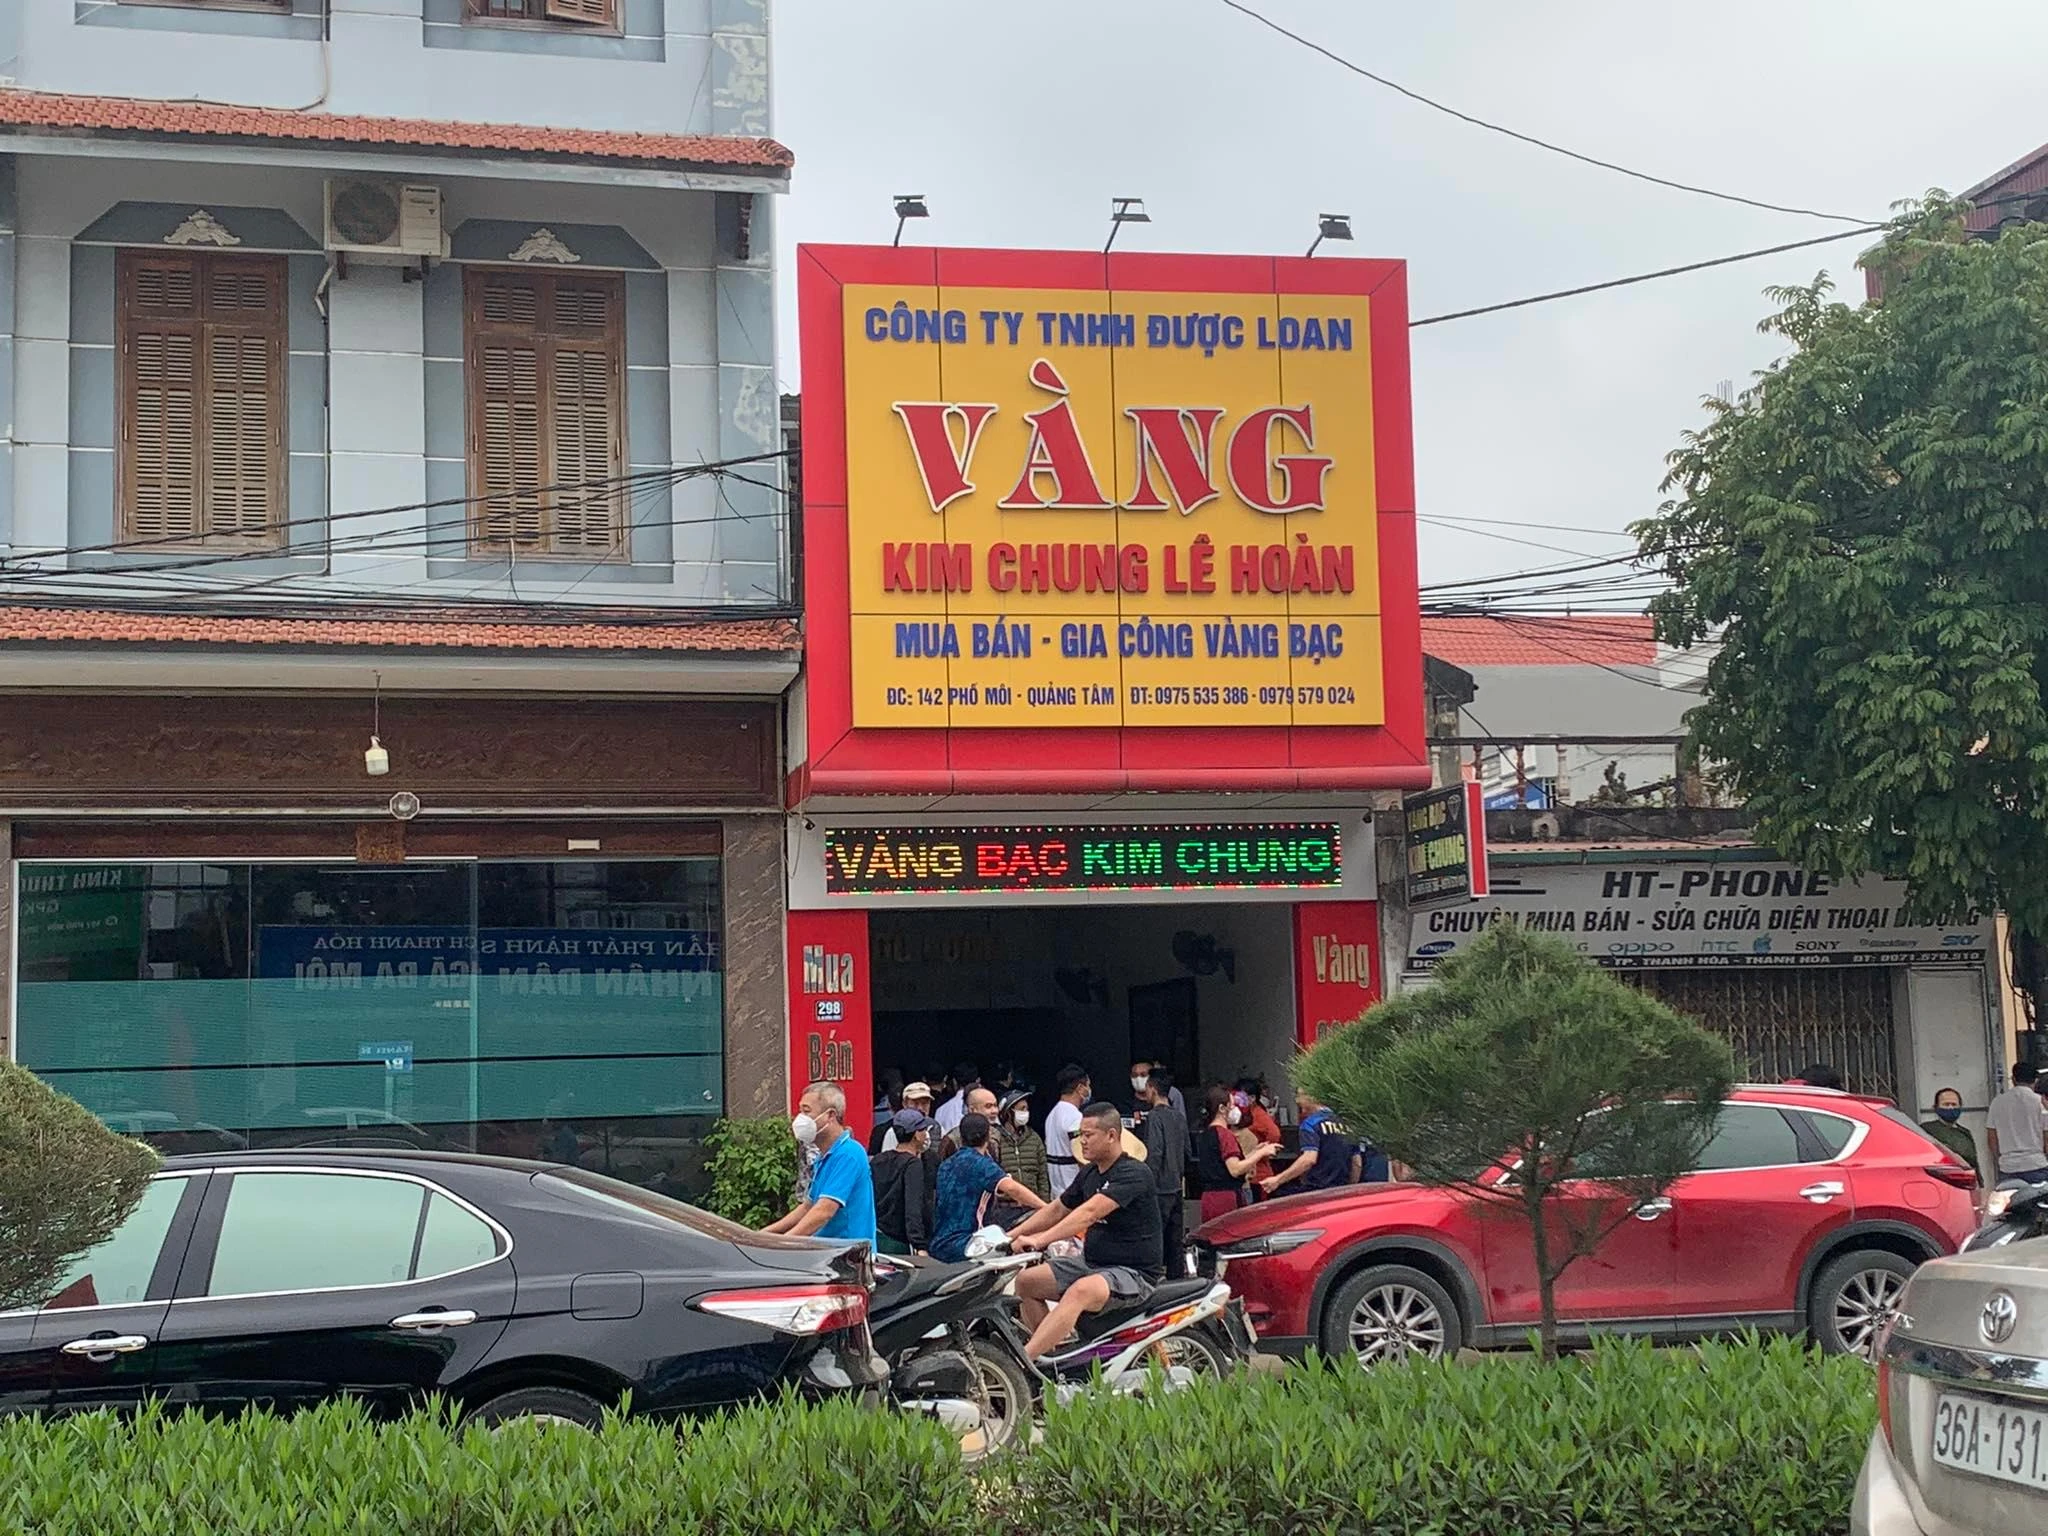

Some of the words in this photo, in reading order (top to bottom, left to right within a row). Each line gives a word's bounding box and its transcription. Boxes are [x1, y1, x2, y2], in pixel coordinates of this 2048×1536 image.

[865, 300, 966, 343] CÔNG
[980, 312, 1022, 344] TY
[1037, 313, 1135, 347] TNHH
[1147, 313, 1243, 357] ĐƯỢC
[1258, 317, 1352, 351] LOAN
[892, 358, 1336, 515] VÀNG
[883, 542, 972, 594] KIM
[988, 543, 1149, 594] CHUNG
[1164, 534, 1216, 594] LÊ
[1231, 533, 1354, 594] HOÀN
[895, 623, 960, 658] MUA
[972, 616, 1031, 658] BÁN
[1061, 623, 1108, 658] GIA
[1119, 616, 1193, 658] CÔNG
[1207, 616, 1278, 658] VÀNG
[1289, 623, 1343, 666] BẠC
[887, 687, 912, 705] ĐC:
[917, 687, 943, 705] 142
[948, 682, 978, 705] PHỐ
[985, 683, 1012, 705] MÔI
[1027, 682, 1076, 707] QUẢNG
[1082, 683, 1114, 705] TÂM
[1155, 687, 1190, 704] 0975
[1193, 687, 1219, 704] 535
[1223, 687, 1248, 704] 386
[1259, 687, 1294, 704] 0979
[1298, 687, 1324, 704] 579
[1328, 687, 1355, 704] 024
[834, 834, 962, 878] VÀNG
[976, 840, 1069, 882] BẠC
[1082, 839, 1163, 876] KIM
[1175, 838, 1333, 875] CHUNG
[1601, 870, 1830, 898] HT-PHONE
[1525, 911, 1575, 932] MUA
[1582, 906, 1630, 932] BÁN
[1652, 901, 1695, 931] SỬA
[1703, 904, 1761, 931] CHỮA
[1768, 905, 1819, 934] ĐIỆN
[1827, 907, 1889, 933] THOẠI
[803, 945, 854, 994] Mua
[1312, 934, 1370, 989] Vàng
[1642, 956, 1694, 966] THANH
[1745, 955, 1795, 965] THANH
[1795, 940, 1840, 951] SONY
[818, 1001, 841, 1015] 298
[808, 1030, 854, 1082] Bán
